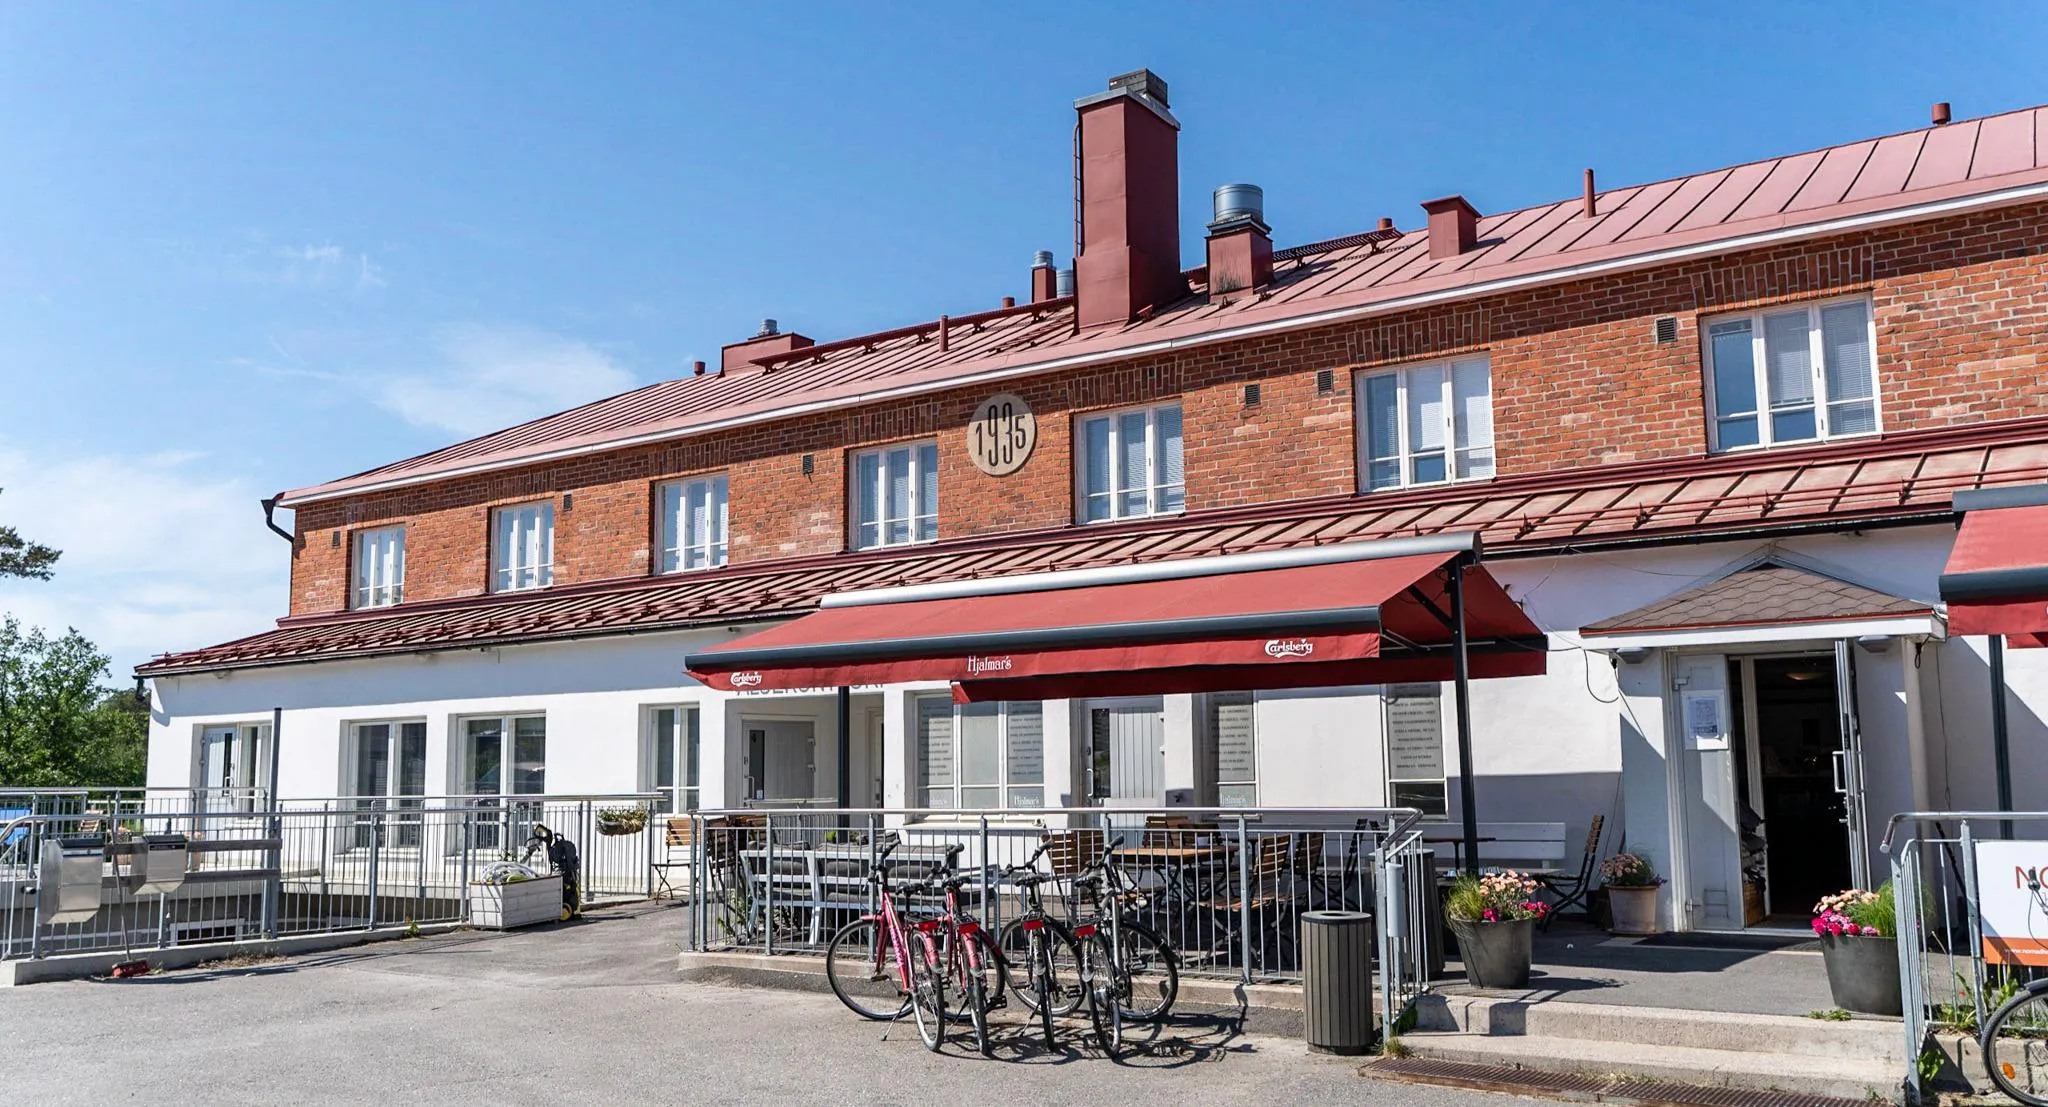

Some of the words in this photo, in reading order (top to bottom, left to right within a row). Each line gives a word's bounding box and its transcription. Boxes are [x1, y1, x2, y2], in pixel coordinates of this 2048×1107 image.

[975, 402, 1026, 466] 1935
[1264, 638, 1313, 658] Carlsberg
[967, 655, 1012, 676] Hjalmar's
[730, 671, 762, 687] Carlsberg
